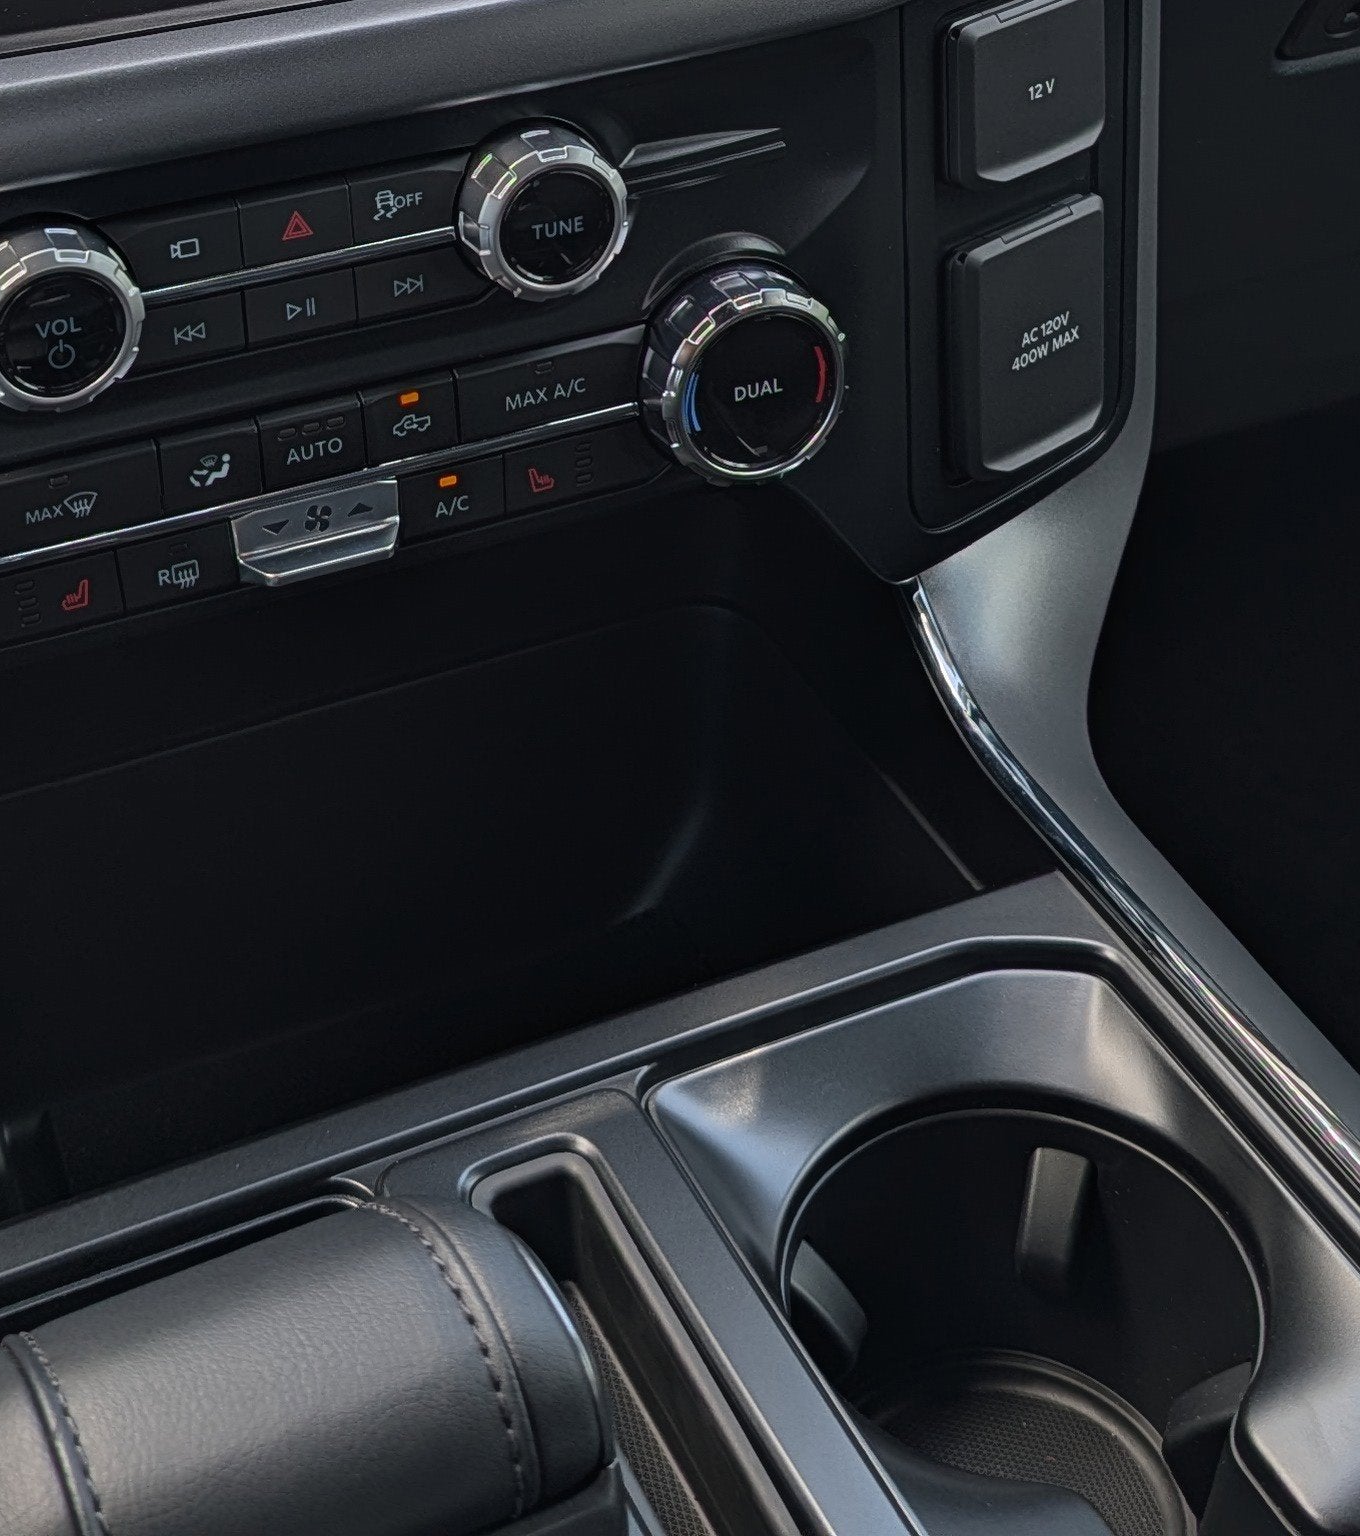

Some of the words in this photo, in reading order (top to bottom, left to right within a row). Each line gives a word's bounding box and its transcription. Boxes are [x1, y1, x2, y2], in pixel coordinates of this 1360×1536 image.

[1028, 81, 1043, 101] 12
[1044, 78, 1055, 94] V
[395, 190, 424, 209] OFF
[531, 215, 584, 241] TUNE
[36, 317, 82, 339] VOL
[1021, 326, 1040, 348] AC
[1040, 311, 1071, 340] 120V
[1011, 341, 1051, 372] 400W
[1053, 325, 1081, 354] MAX
[505, 386, 548, 412] MAX
[552, 377, 586, 400] A/C
[734, 377, 783, 403] DUAL
[286, 438, 343, 465] AUTO
[25, 504, 64, 526] MAX
[435, 495, 469, 518] A/C
